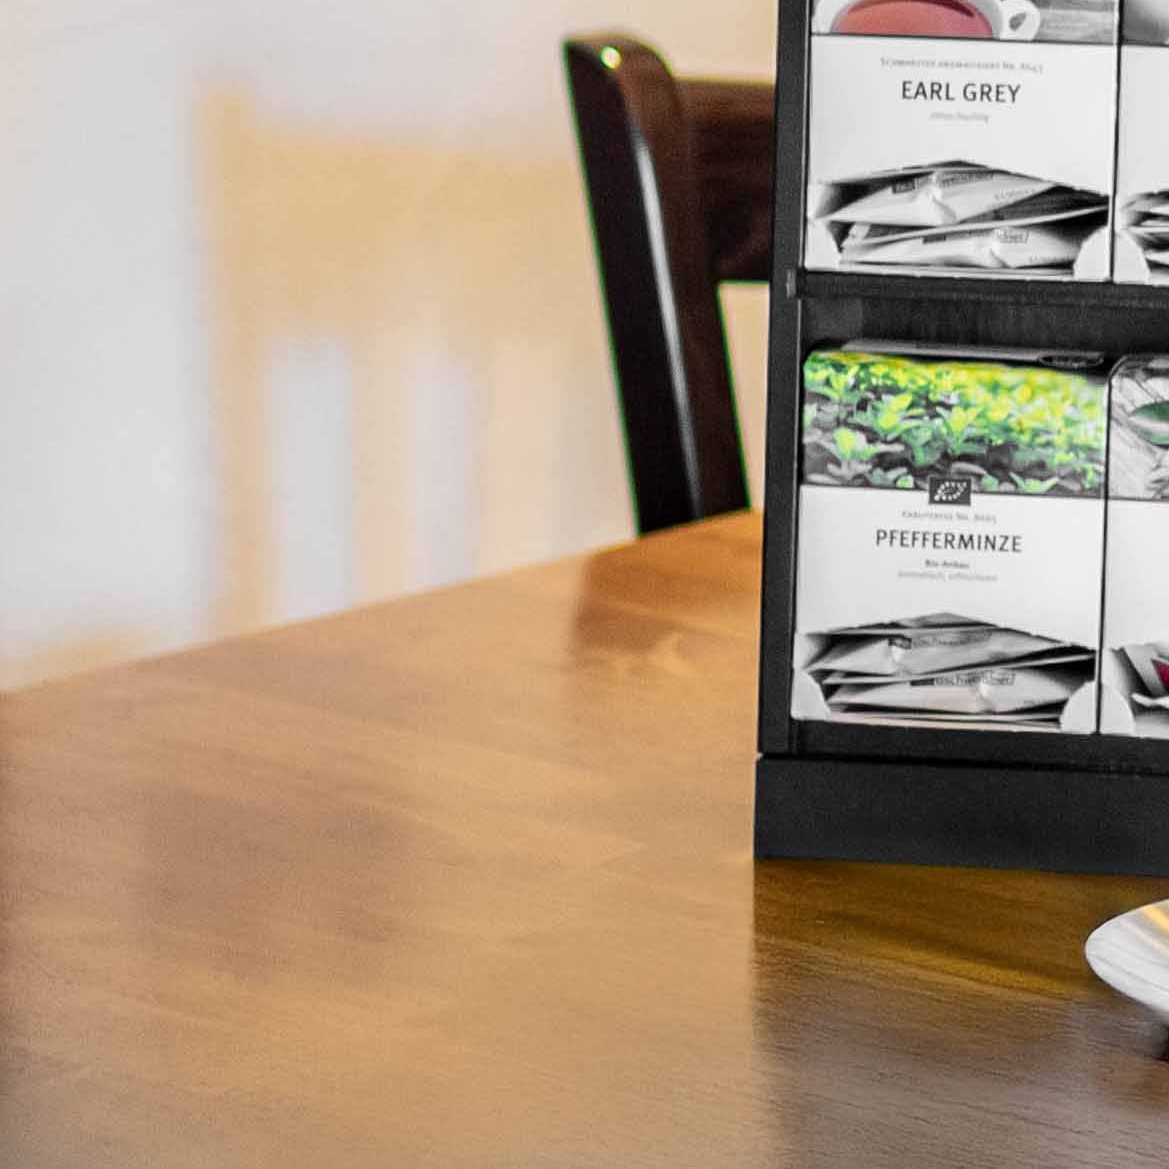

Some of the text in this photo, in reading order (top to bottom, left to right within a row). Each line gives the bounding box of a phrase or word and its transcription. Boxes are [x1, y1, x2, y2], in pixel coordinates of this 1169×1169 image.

[901, 80, 1021, 103] EARL GREY
[875, 529, 1023, 553] PFEFFERMINZE
